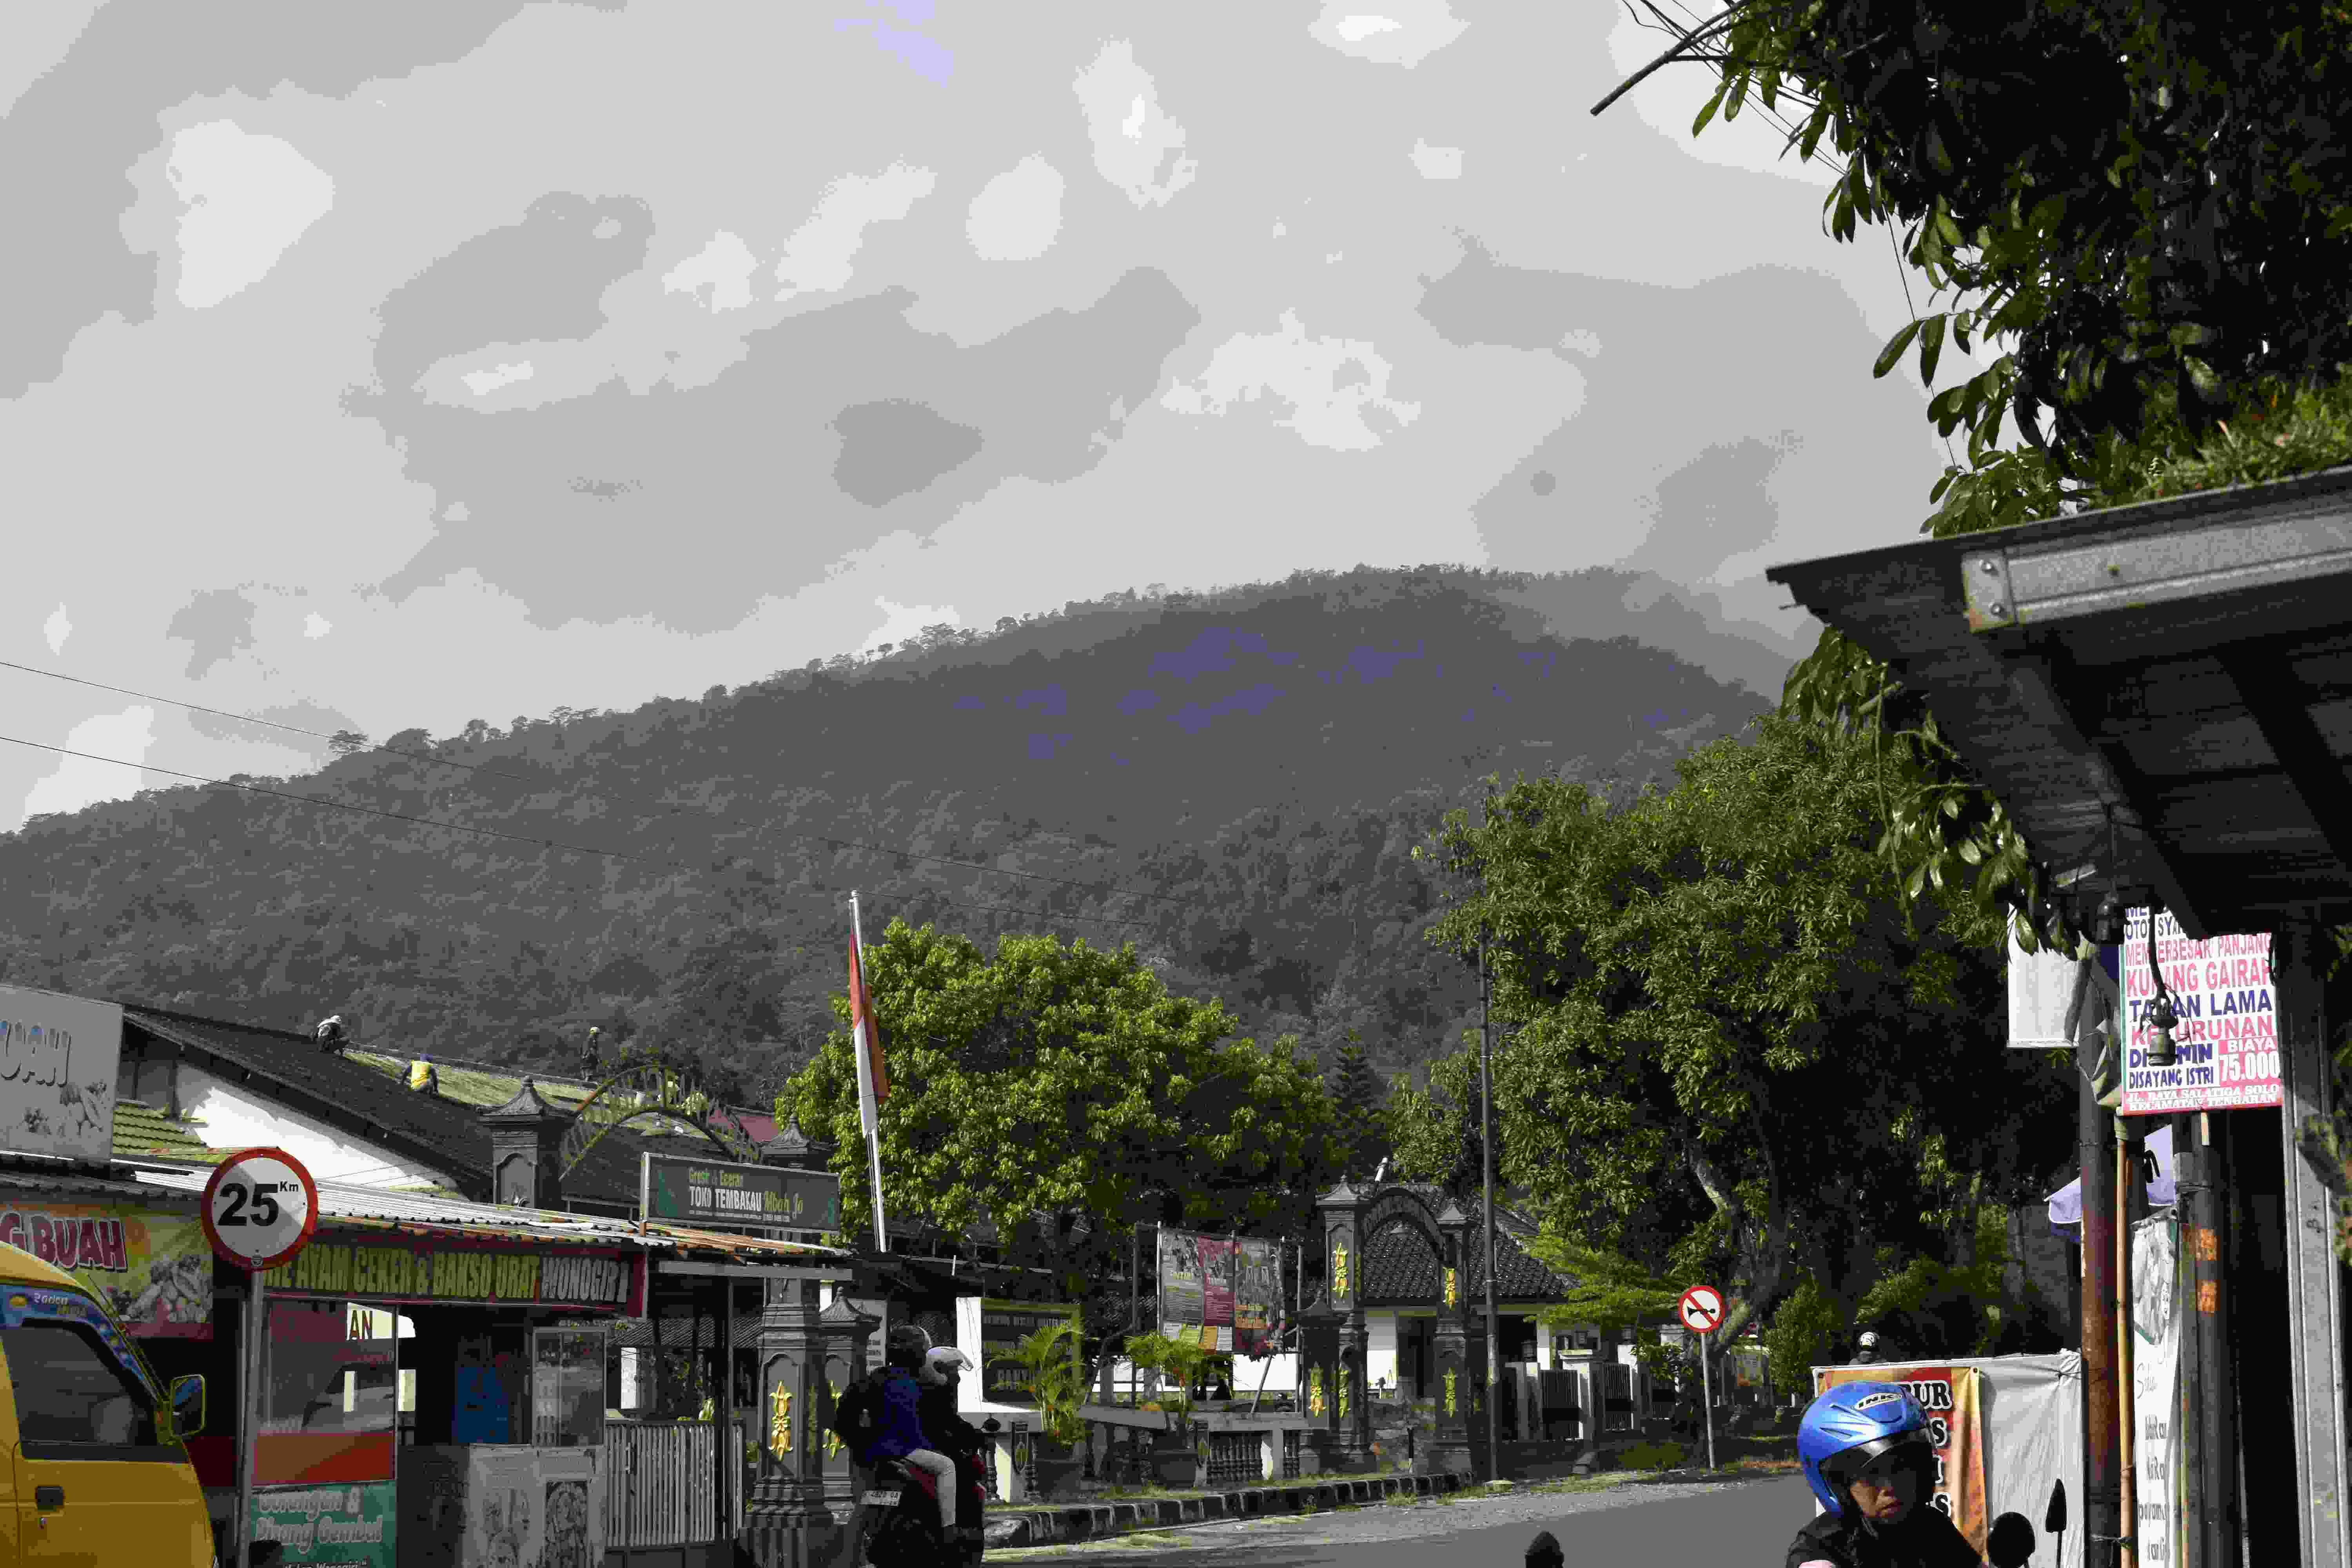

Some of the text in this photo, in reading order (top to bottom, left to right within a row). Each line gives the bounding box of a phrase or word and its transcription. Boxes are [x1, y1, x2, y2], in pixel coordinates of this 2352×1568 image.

[2125, 919, 2149, 940] OTO
[2126, 940, 2212, 966] MEMERBESAR
[2129, 989, 2272, 1022] TAAN LAMA
[2131, 1015, 2272, 1046] KEURUNAN
[2129, 1043, 2213, 1068] DIMIN
[2229, 1038, 2275, 1052] BIAYA
[2129, 1066, 2214, 1089] DISAYANG ISTRI
[2220, 1051, 2281, 1082] 75.000
[2245, 1084, 2279, 1095] SOLO
[217, 1181, 299, 1227] 25 Km
[690, 1186, 712, 1208] TOKO
[715, 1188, 762, 1212] TEMBAKAU
[31, 1215, 129, 1272] BUAH
[295, 1242, 352, 1291] AYAM
[433, 1251, 492, 1299] BAKSO
